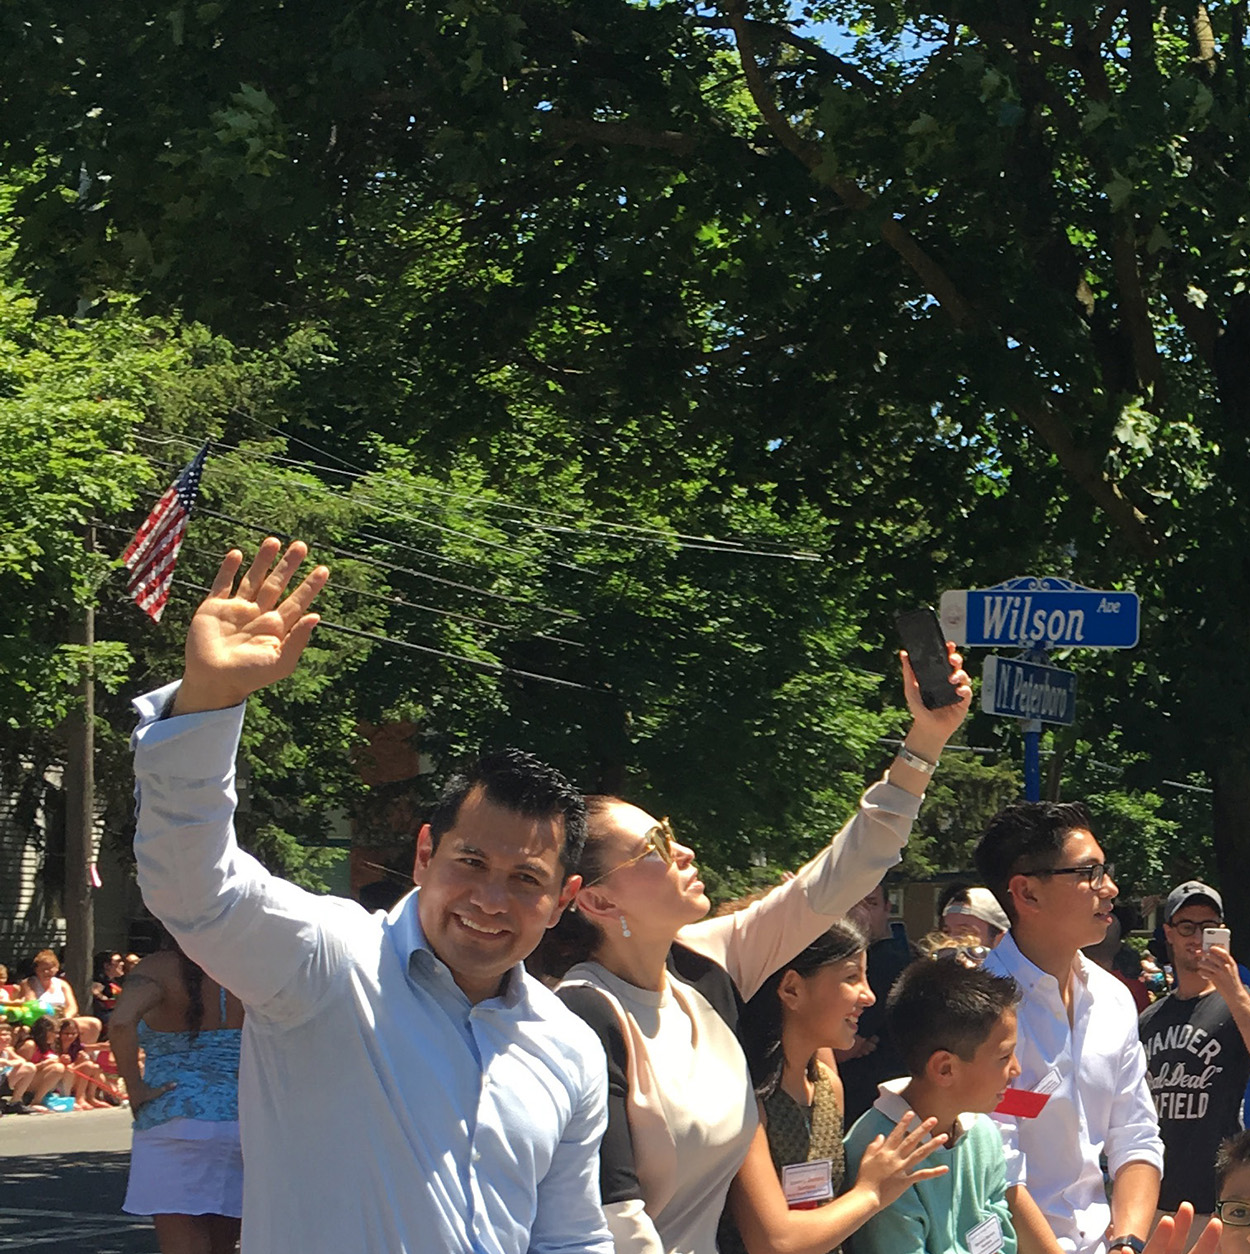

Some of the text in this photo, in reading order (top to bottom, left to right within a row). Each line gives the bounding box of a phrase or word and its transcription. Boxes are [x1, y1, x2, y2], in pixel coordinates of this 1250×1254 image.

[983, 595, 1121, 641] Wilson Ave
[1144, 1023, 1221, 1065] VANDER
[1154, 1092, 1209, 1119] FIELD
